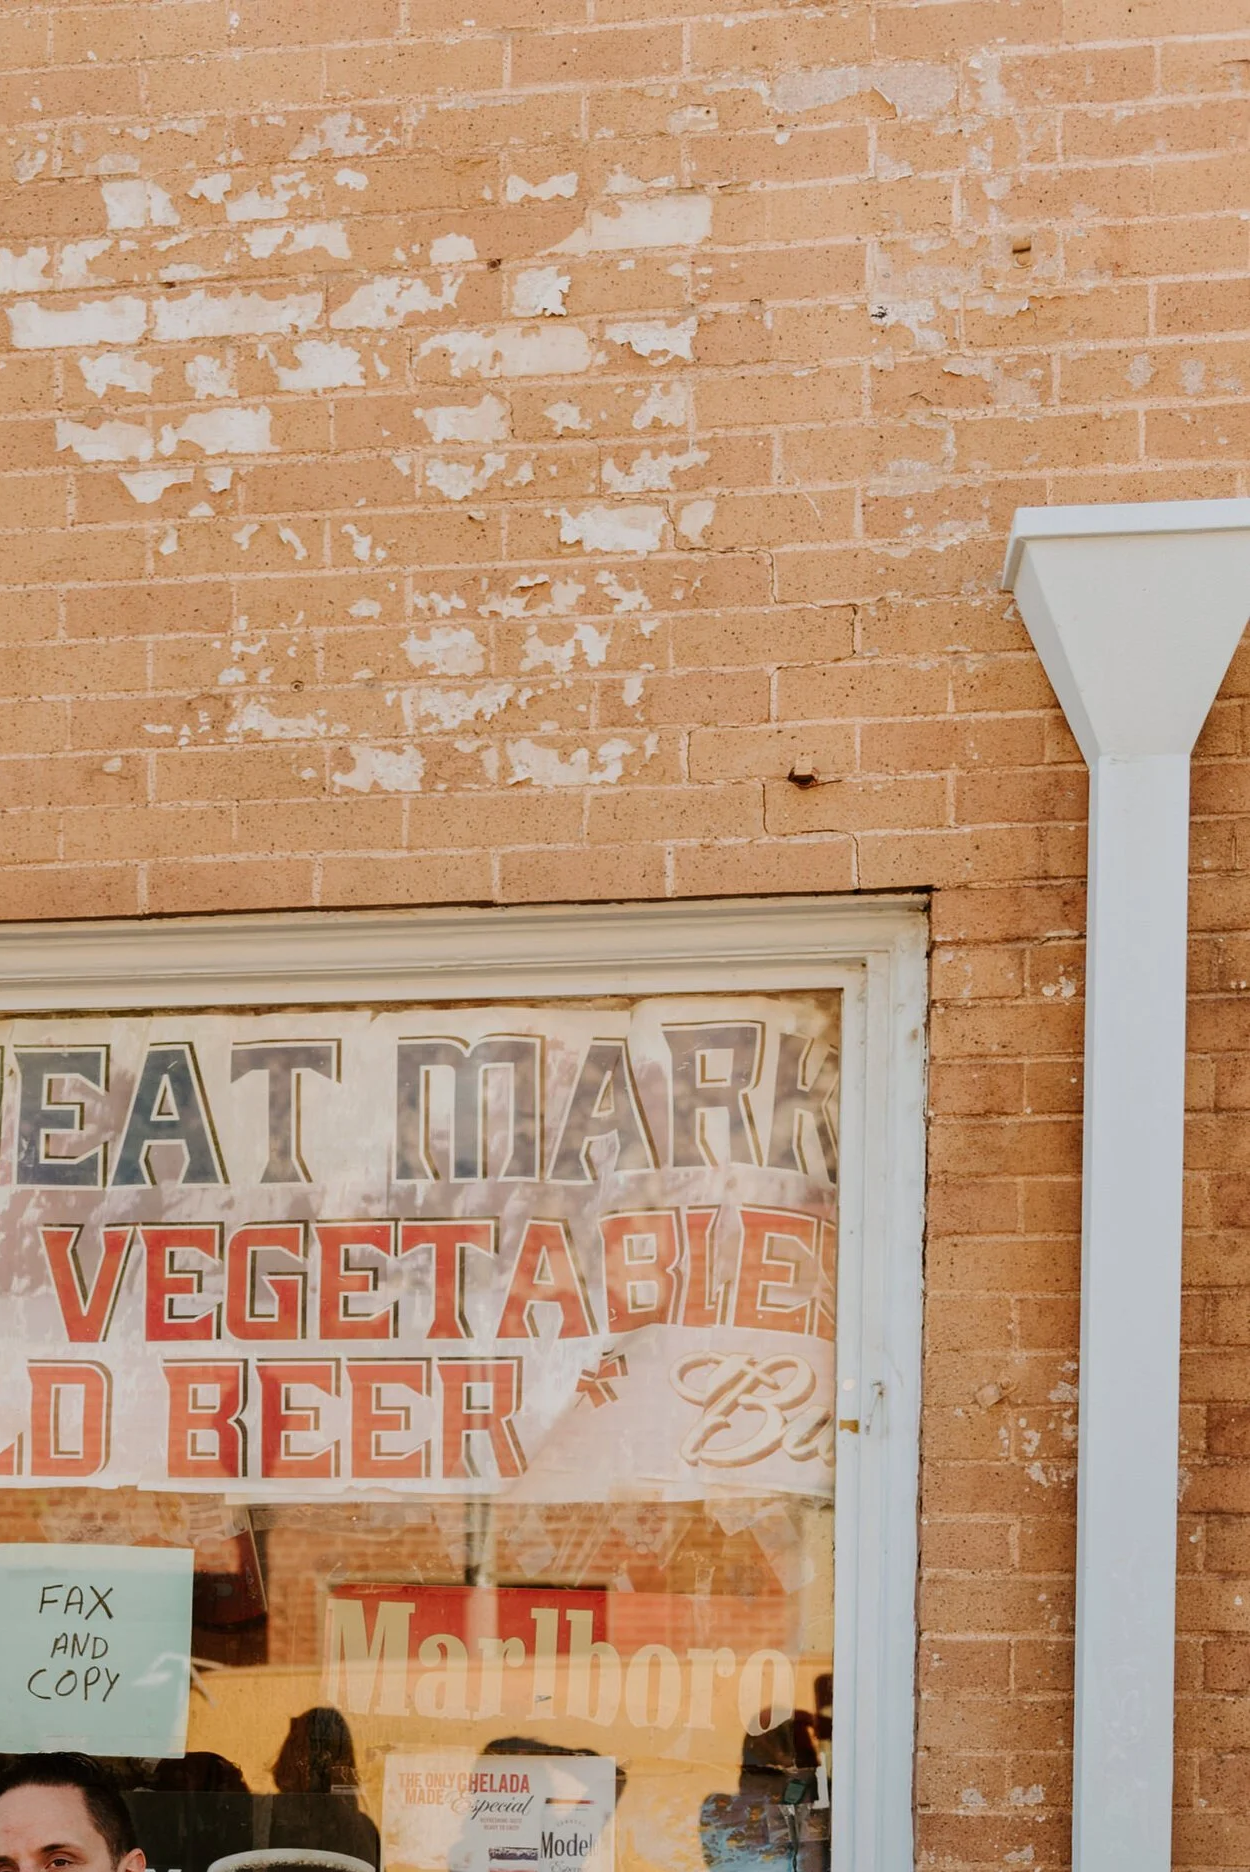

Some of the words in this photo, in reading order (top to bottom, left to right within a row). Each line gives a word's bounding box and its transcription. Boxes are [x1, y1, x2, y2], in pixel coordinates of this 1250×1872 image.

[162, 1356, 530, 1480] BEER
[38, 1584, 115, 1621] FAX
[50, 1631, 109, 1661] AND
[26, 1665, 121, 1703] COPY
[326, 1597, 795, 1738] Marlboro
[397, 1772, 424, 1789] THE
[424, 1772, 456, 1789] ONLY
[456, 1772, 531, 1794] CHELADA
[404, 1788, 445, 1806] MADE
